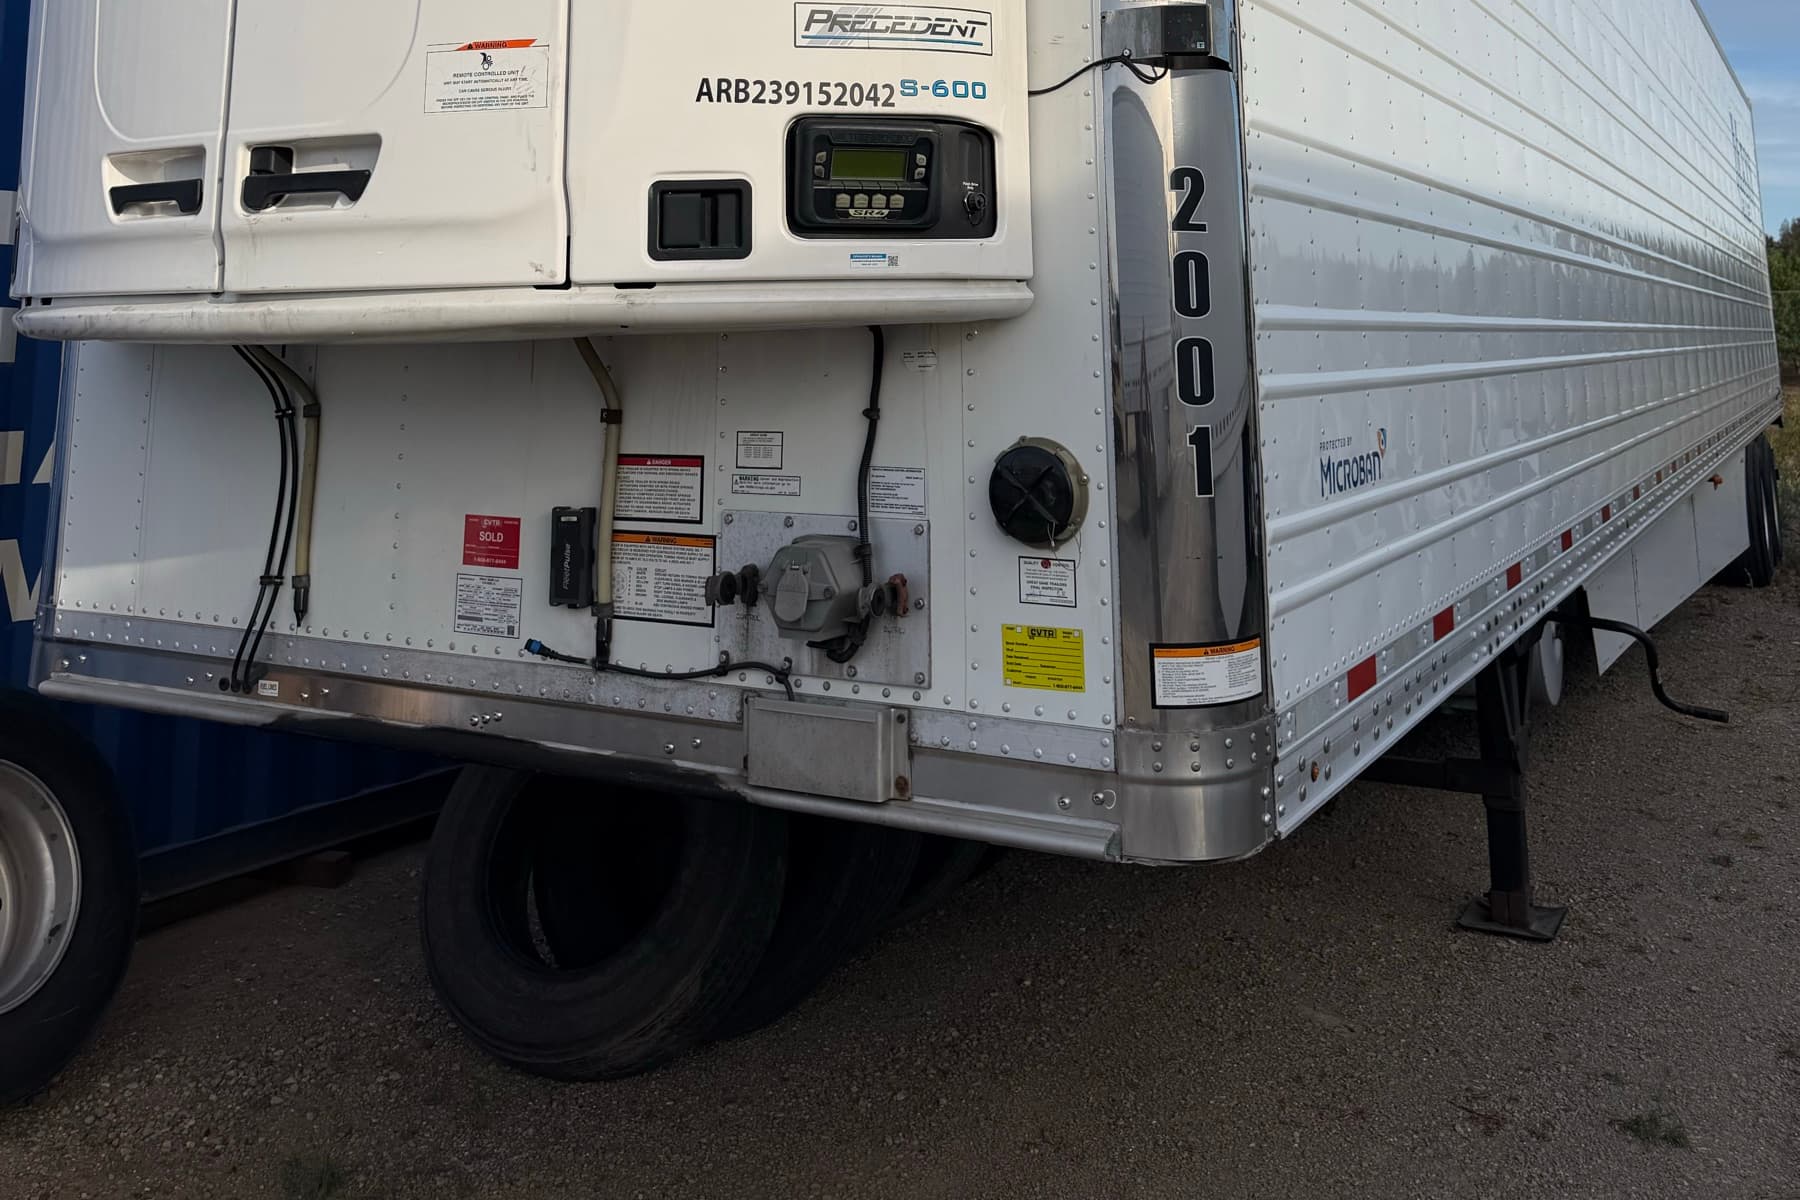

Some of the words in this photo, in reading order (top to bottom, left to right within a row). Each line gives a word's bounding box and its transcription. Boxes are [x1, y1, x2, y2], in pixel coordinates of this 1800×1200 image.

[803, 8, 988, 39] PRECEDENT
[474, 40, 507, 49] WARNING
[695, 77, 896, 108] ARB239152042
[899, 78, 987, 100] S-600
[1319, 437, 1346, 451] PROTECTED
[1346, 436, 1352, 447] BY
[479, 530, 504, 543] SOLD
[652, 535, 678, 544] WARNING
[562, 543, 571, 590] FleetPulse
[1030, 628, 1055, 637] CVTR
[1209, 645, 1236, 655] WARNING
